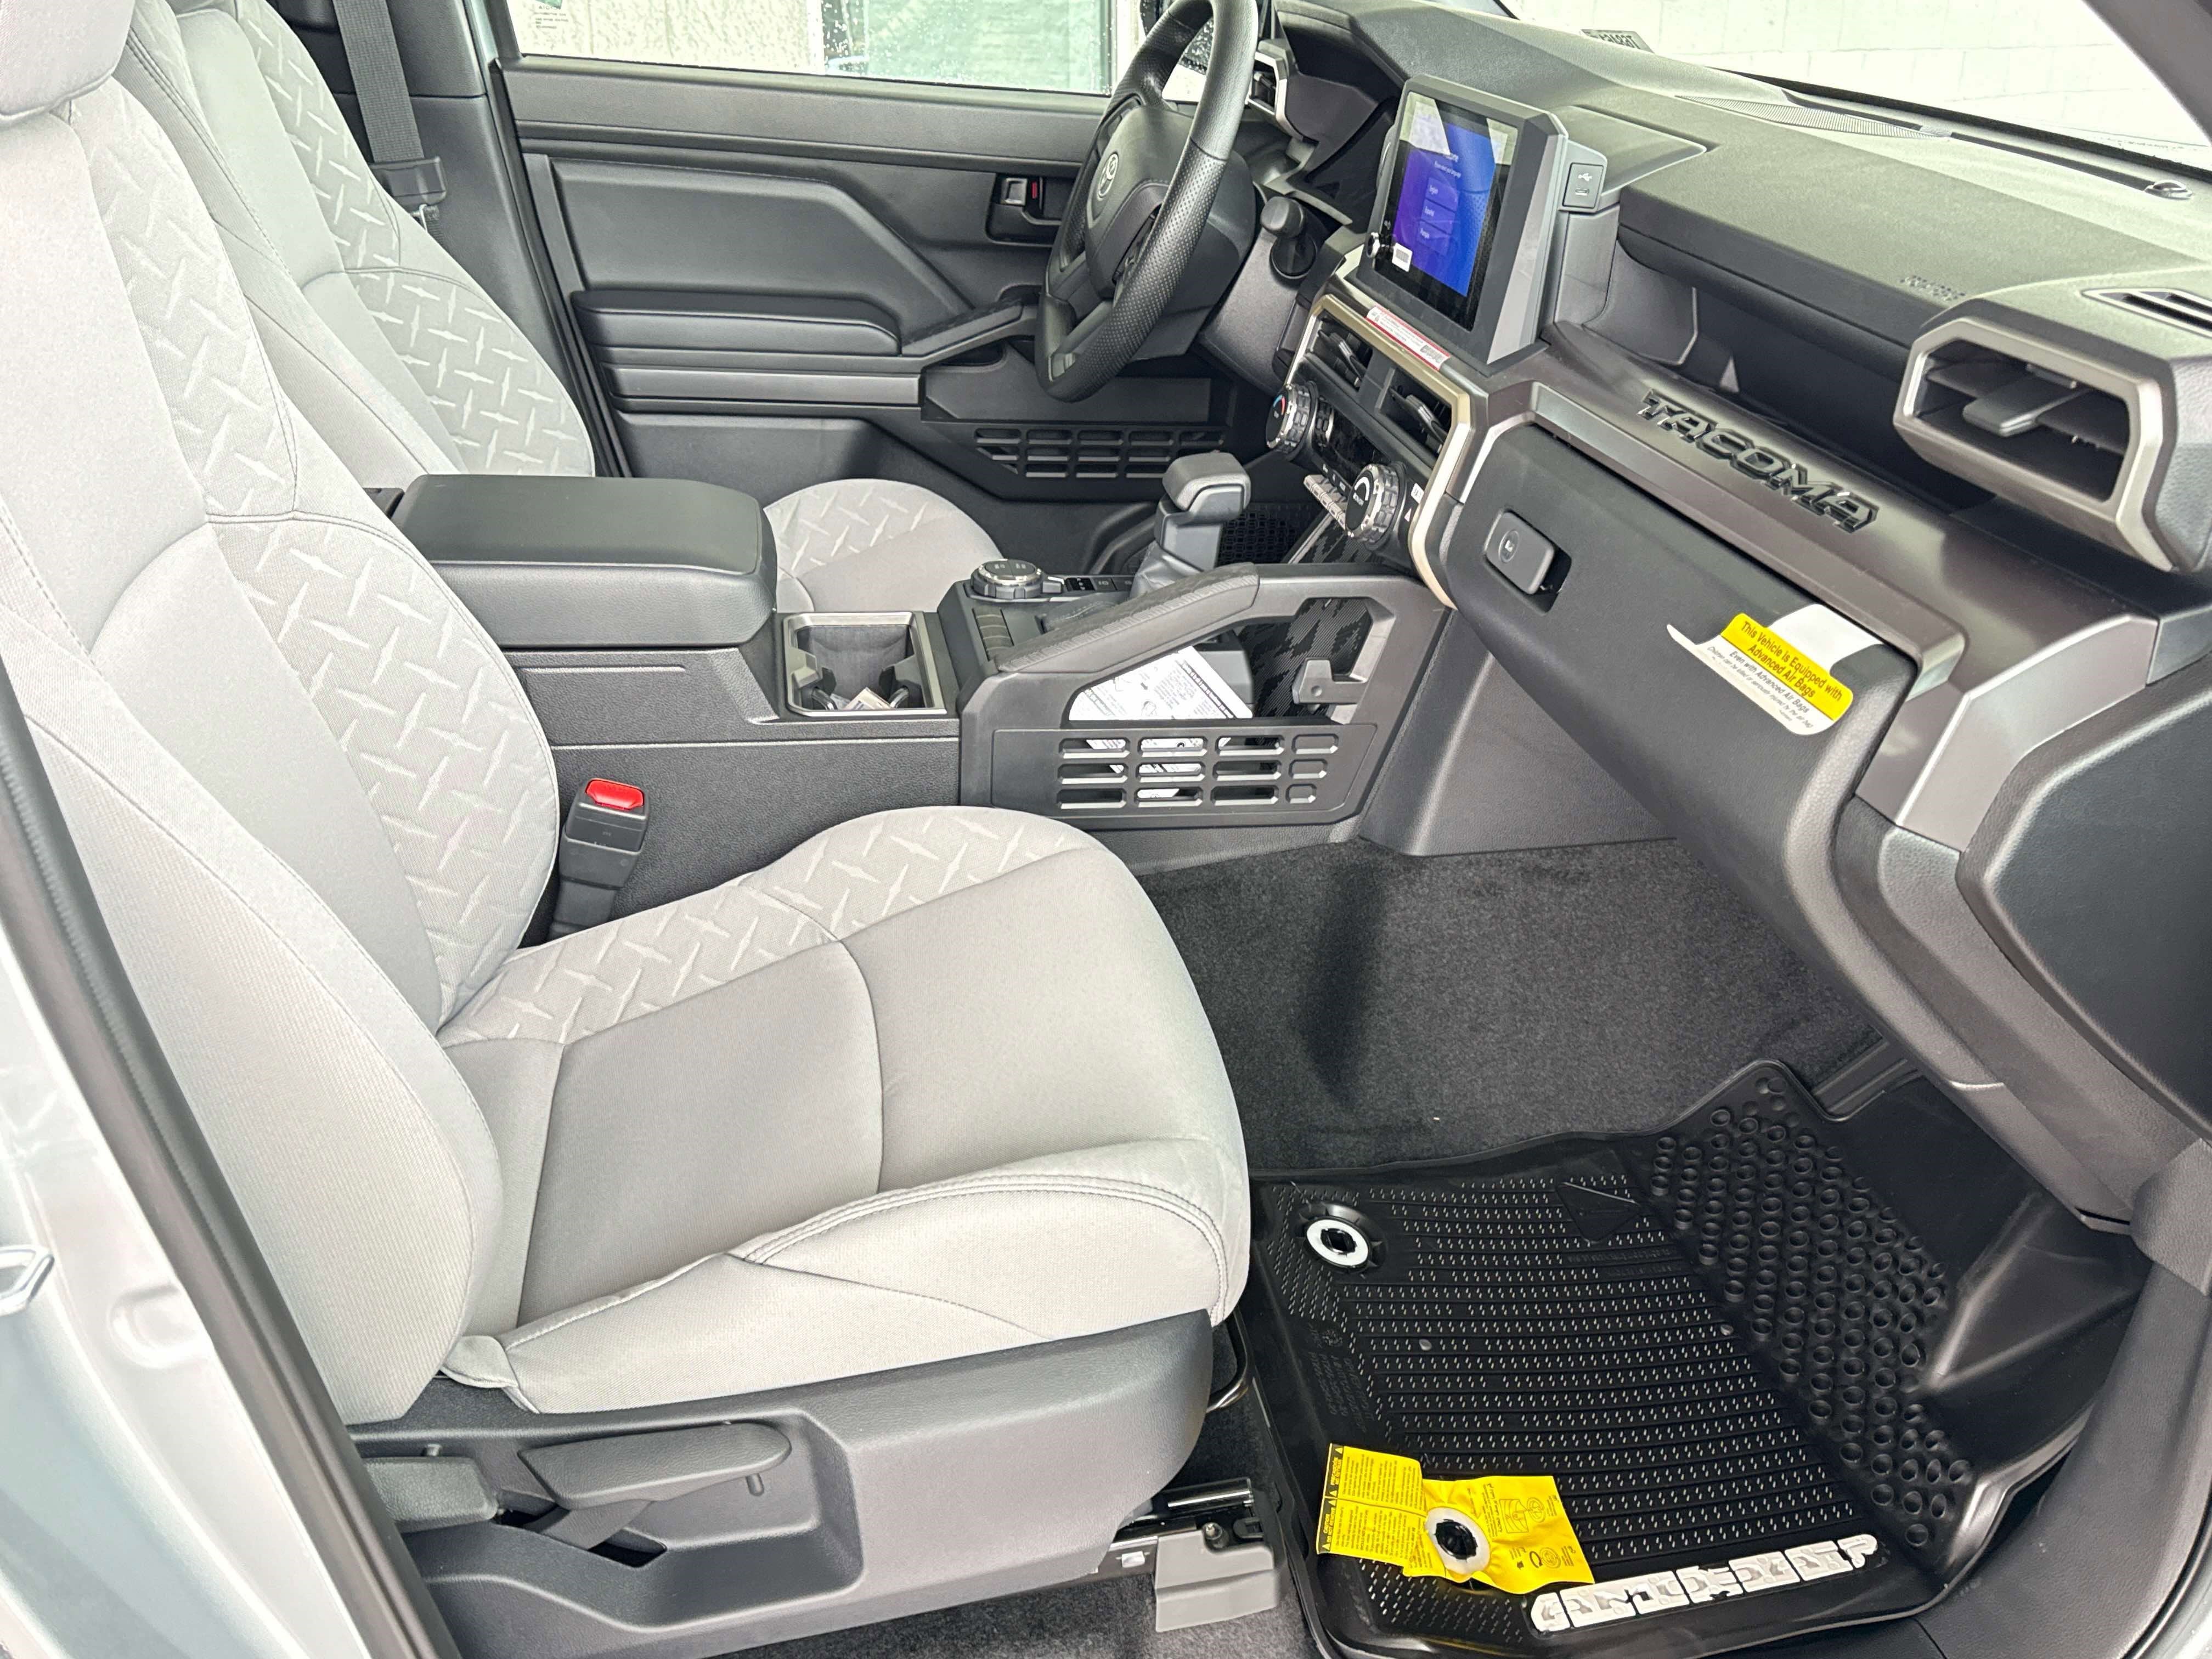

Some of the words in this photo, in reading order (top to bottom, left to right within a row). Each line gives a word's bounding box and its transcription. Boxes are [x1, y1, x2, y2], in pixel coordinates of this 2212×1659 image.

[1637, 388, 1880, 534] TACOMA
[1729, 651, 1745, 664] Even
[1744, 662, 1757, 673] with
[1755, 671, 1786, 693] Advanced
[1782, 692, 1795, 701] Air
[1792, 698, 1810, 713] Bags
[1741, 621, 1757, 639] This
[1757, 632, 1783, 657] Vehicle
[1790, 656, 1827, 689] Equipped
[1824, 684, 1843, 701] with
[1747, 644, 1786, 674] Advanced
[1782, 670, 1797, 682] Air
[1794, 678, 1816, 697] Bags
